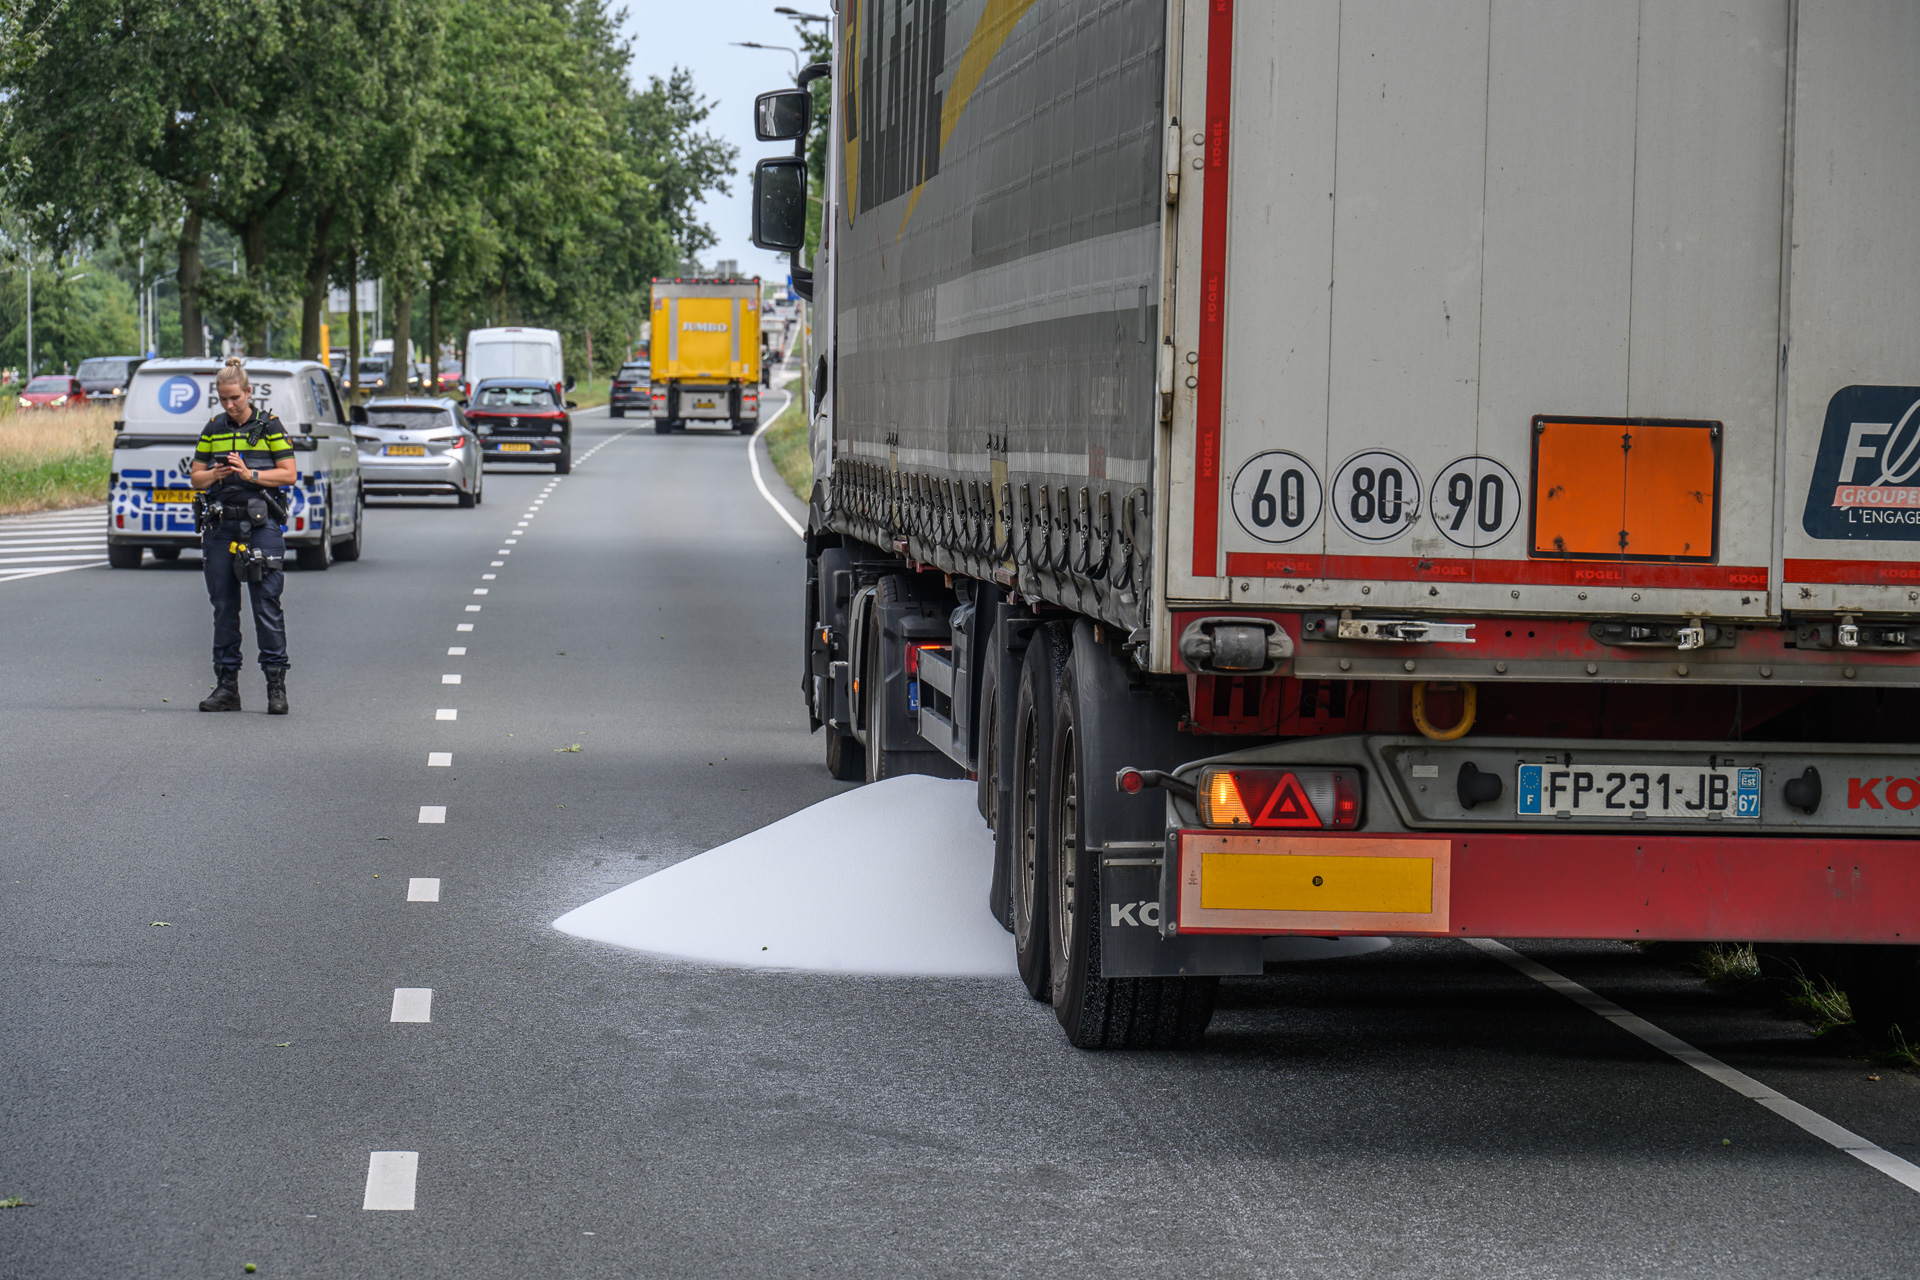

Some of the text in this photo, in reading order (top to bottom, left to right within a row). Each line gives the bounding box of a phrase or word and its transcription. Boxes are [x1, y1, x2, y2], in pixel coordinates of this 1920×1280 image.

[1212, 120, 1222, 167] KÖGEL
[1207, 275, 1218, 323] KÖGEL
[682, 321, 728, 333] JUMBO
[209, 382, 272, 396] PTS
[1203, 430, 1214, 478] KÖGEL
[1251, 468, 1305, 528] 60
[1350, 467, 1403, 525] 80
[1448, 472, 1504, 533] 90
[1841, 489, 1920, 505] GROUPE
[1575, 569, 1622, 580] KÖGEL
[1880, 568, 1920, 579] KÖGE
[1549, 771, 1729, 811] FP-231-JB
[1741, 778, 1756, 786] Est
[1526, 794, 1535, 806] F
[1738, 794, 1758, 812] 67
